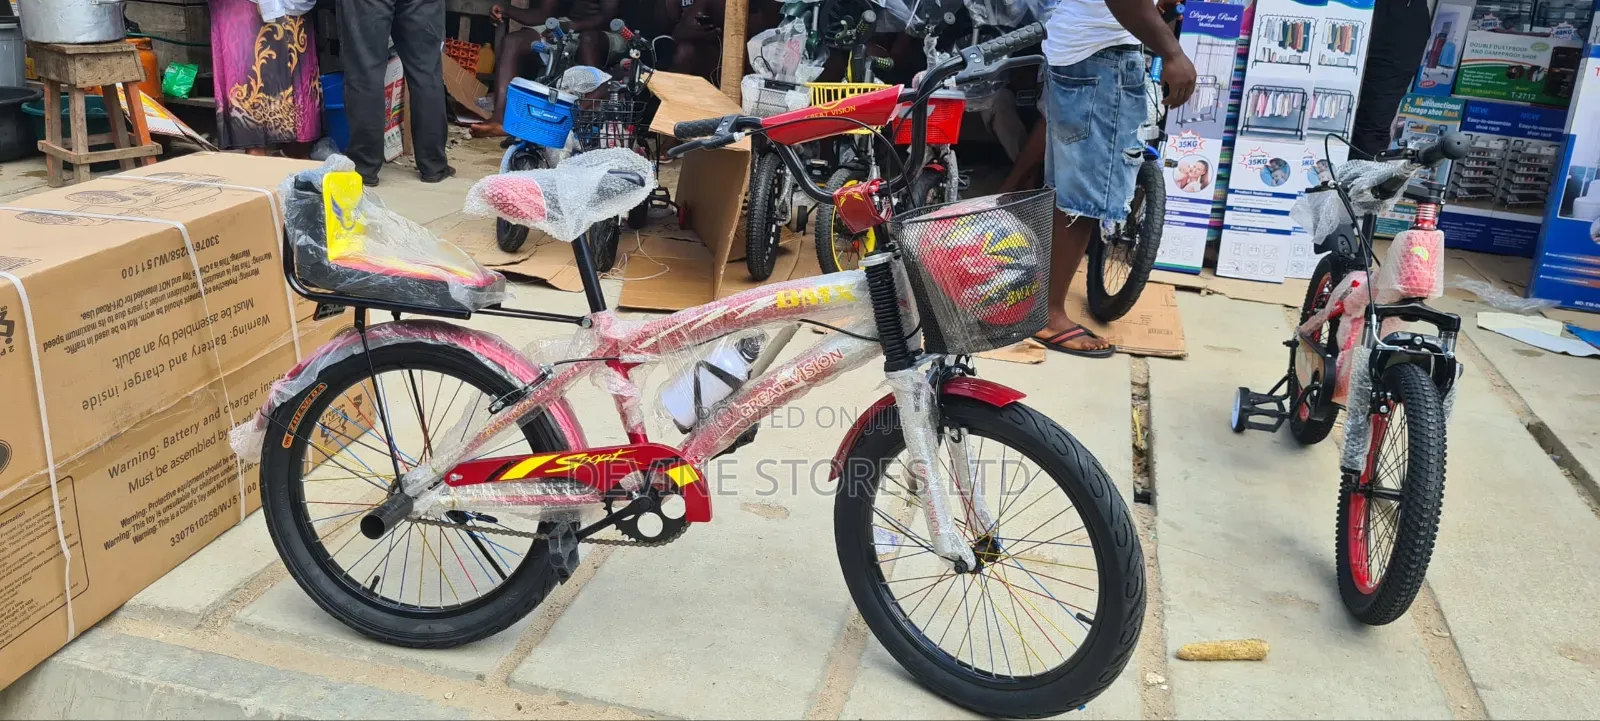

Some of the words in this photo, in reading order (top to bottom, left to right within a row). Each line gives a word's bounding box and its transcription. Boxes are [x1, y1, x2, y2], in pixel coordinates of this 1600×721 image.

[831, 105, 857, 116] VISION
[1403, 103, 1427, 115] Storage
[1415, 97, 1461, 110] Multifunctional
[1178, 140, 1198, 148] 35KG
[159, 279, 171, 292] NOT
[171, 276, 181, 286] and
[167, 285, 189, 298] children
[124, 294, 133, 304] for
[149, 294, 166, 306] under
[233, 297, 254, 315] Must
[127, 301, 144, 315] years
[164, 299, 183, 314] should
[221, 307, 232, 319] be
[107, 315, 114, 323] to
[115, 310, 126, 320] due
[98, 318, 106, 327] its
[111, 325, 119, 334] be
[120, 322, 127, 331] to
[127, 317, 138, 329] Not
[172, 313, 219, 344] assembled
[230, 314, 270, 339] Warning:
[65, 322, 97, 341] maximum
[94, 329, 110, 343] used
[43, 335, 64, 352] speed
[87, 336, 93, 345] in
[143, 341, 155, 354] an
[158, 334, 170, 348] by
[192, 334, 227, 357] Battery
[112, 348, 141, 369] adult.
[169, 352, 187, 371] and
[123, 364, 165, 391] charger
[740, 377, 791, 419] GREAT
[793, 347, 845, 386] VISION
[82, 386, 119, 410] inside
[108, 445, 159, 479] Warning:
[163, 421, 199, 449] Battery
[203, 407, 220, 426] and
[224, 389, 258, 414] charger
[128, 471, 154, 494] Must
[156, 464, 168, 477] be
[170, 432, 216, 469] assembled
[218, 428, 228, 441] by
[120, 508, 147, 528] Warning:
[148, 490, 176, 512] Protective
[132, 524, 158, 544] Warning:
[158, 517, 170, 528] This
[214, 478, 229, 491] NOT
[925, 499, 942, 537] VISION
[104, 529, 131, 550] Warning:
[132, 520, 145, 532] This
[146, 514, 155, 524] toy
